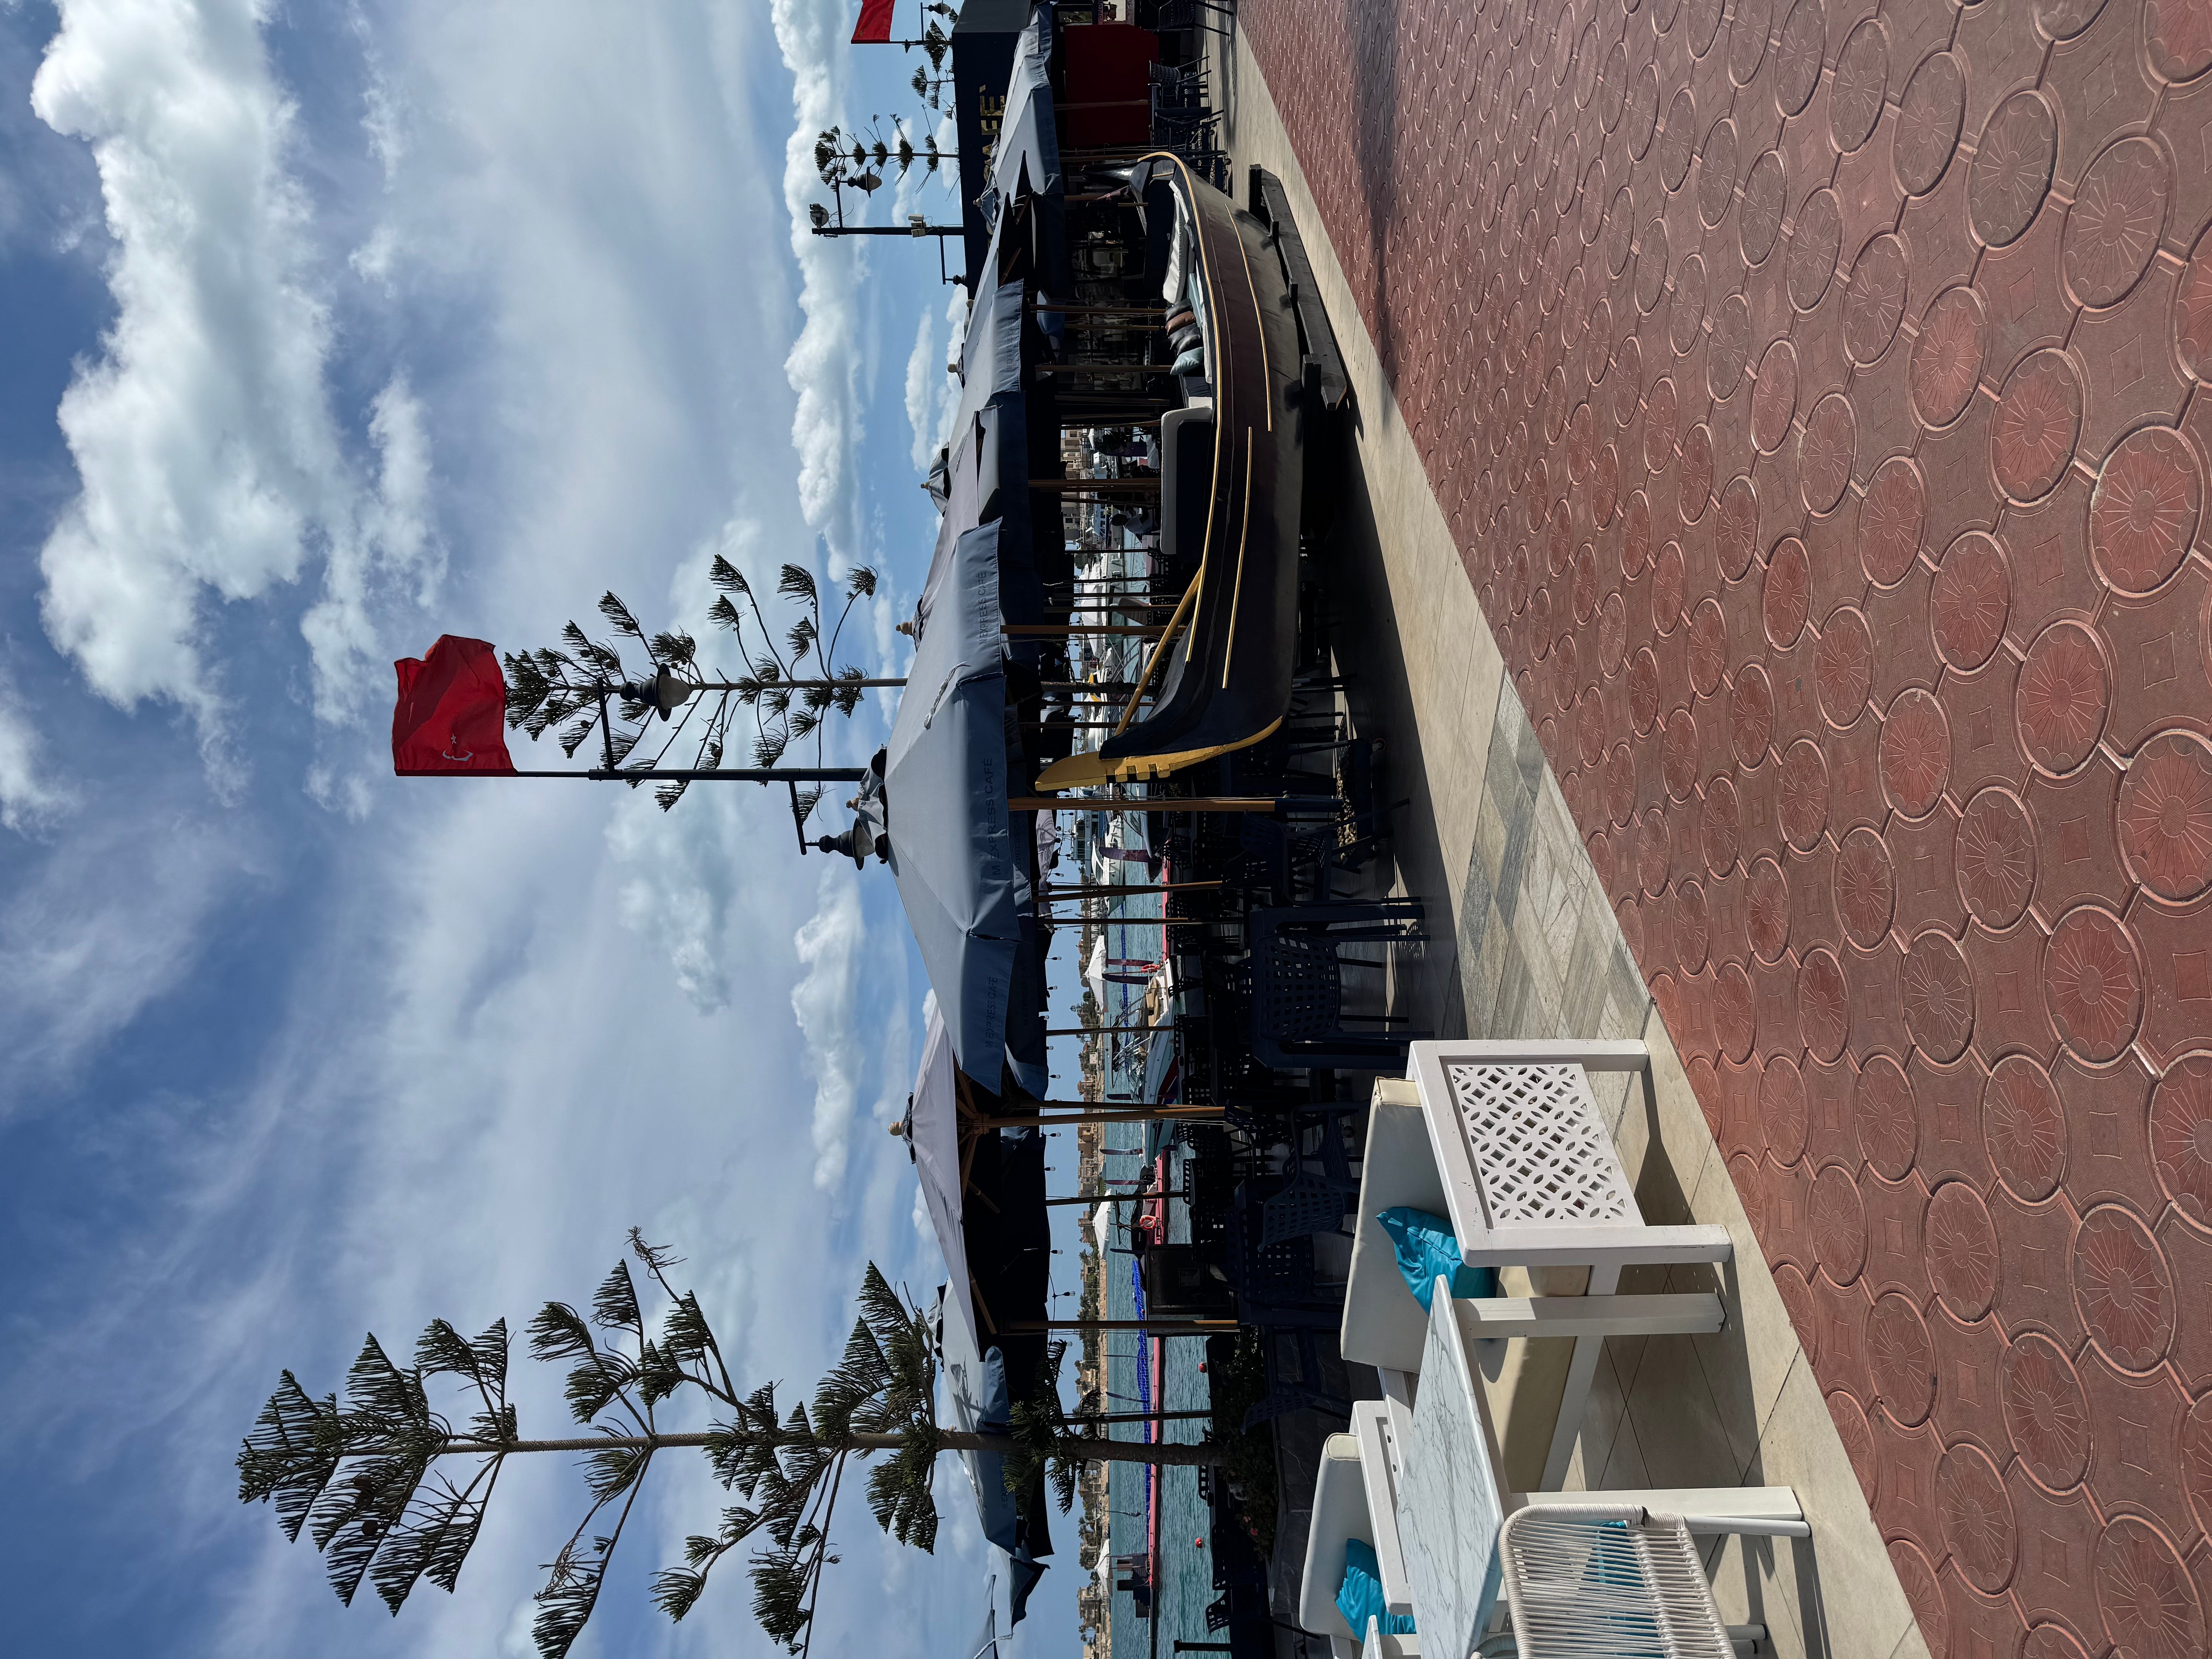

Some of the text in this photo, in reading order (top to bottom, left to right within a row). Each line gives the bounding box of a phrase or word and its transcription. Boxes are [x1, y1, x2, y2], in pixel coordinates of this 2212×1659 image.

[978, 598, 988, 638] EXPRESS
[981, 757, 1001, 876] M EXPRESS CAFÉ
[986, 976, 998, 999] CAFÉ
[985, 1000, 996, 1039] EXPRESS
